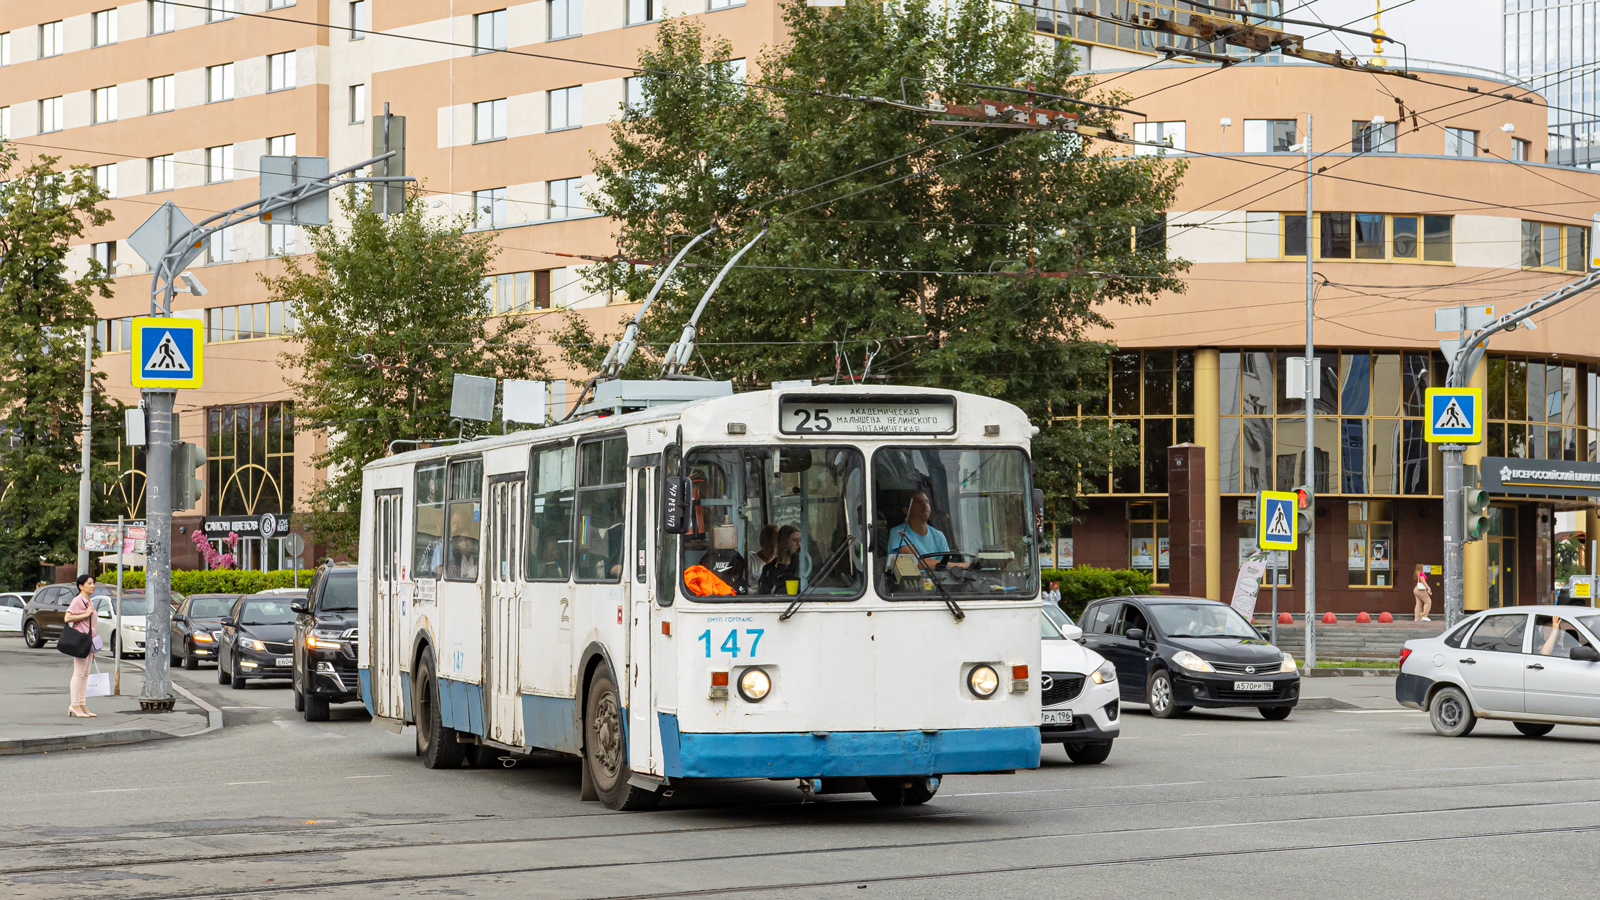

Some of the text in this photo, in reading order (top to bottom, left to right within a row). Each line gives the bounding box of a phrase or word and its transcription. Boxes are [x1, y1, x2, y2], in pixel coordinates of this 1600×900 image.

[850, 408, 920, 416] АКАДЕМИЧЕСКАЯ
[793, 408, 832, 432] 25
[836, 416, 881, 424] МАЛЫШЕВА
[856, 424, 920, 432] БОТАНИЧЕСКАЯ
[1512, 469, 1574, 481] ВСЕРОССИЙСКИЙ
[204, 521, 231, 531] САЛОН
[231, 521, 258, 532] ЦВЕТОВ
[713, 561, 730, 570] NIKE
[560, 597, 570, 624] 2
[698, 628, 765, 658] 147
[452, 650, 464, 674] 147
[1041, 711, 1071, 723] РА 196
